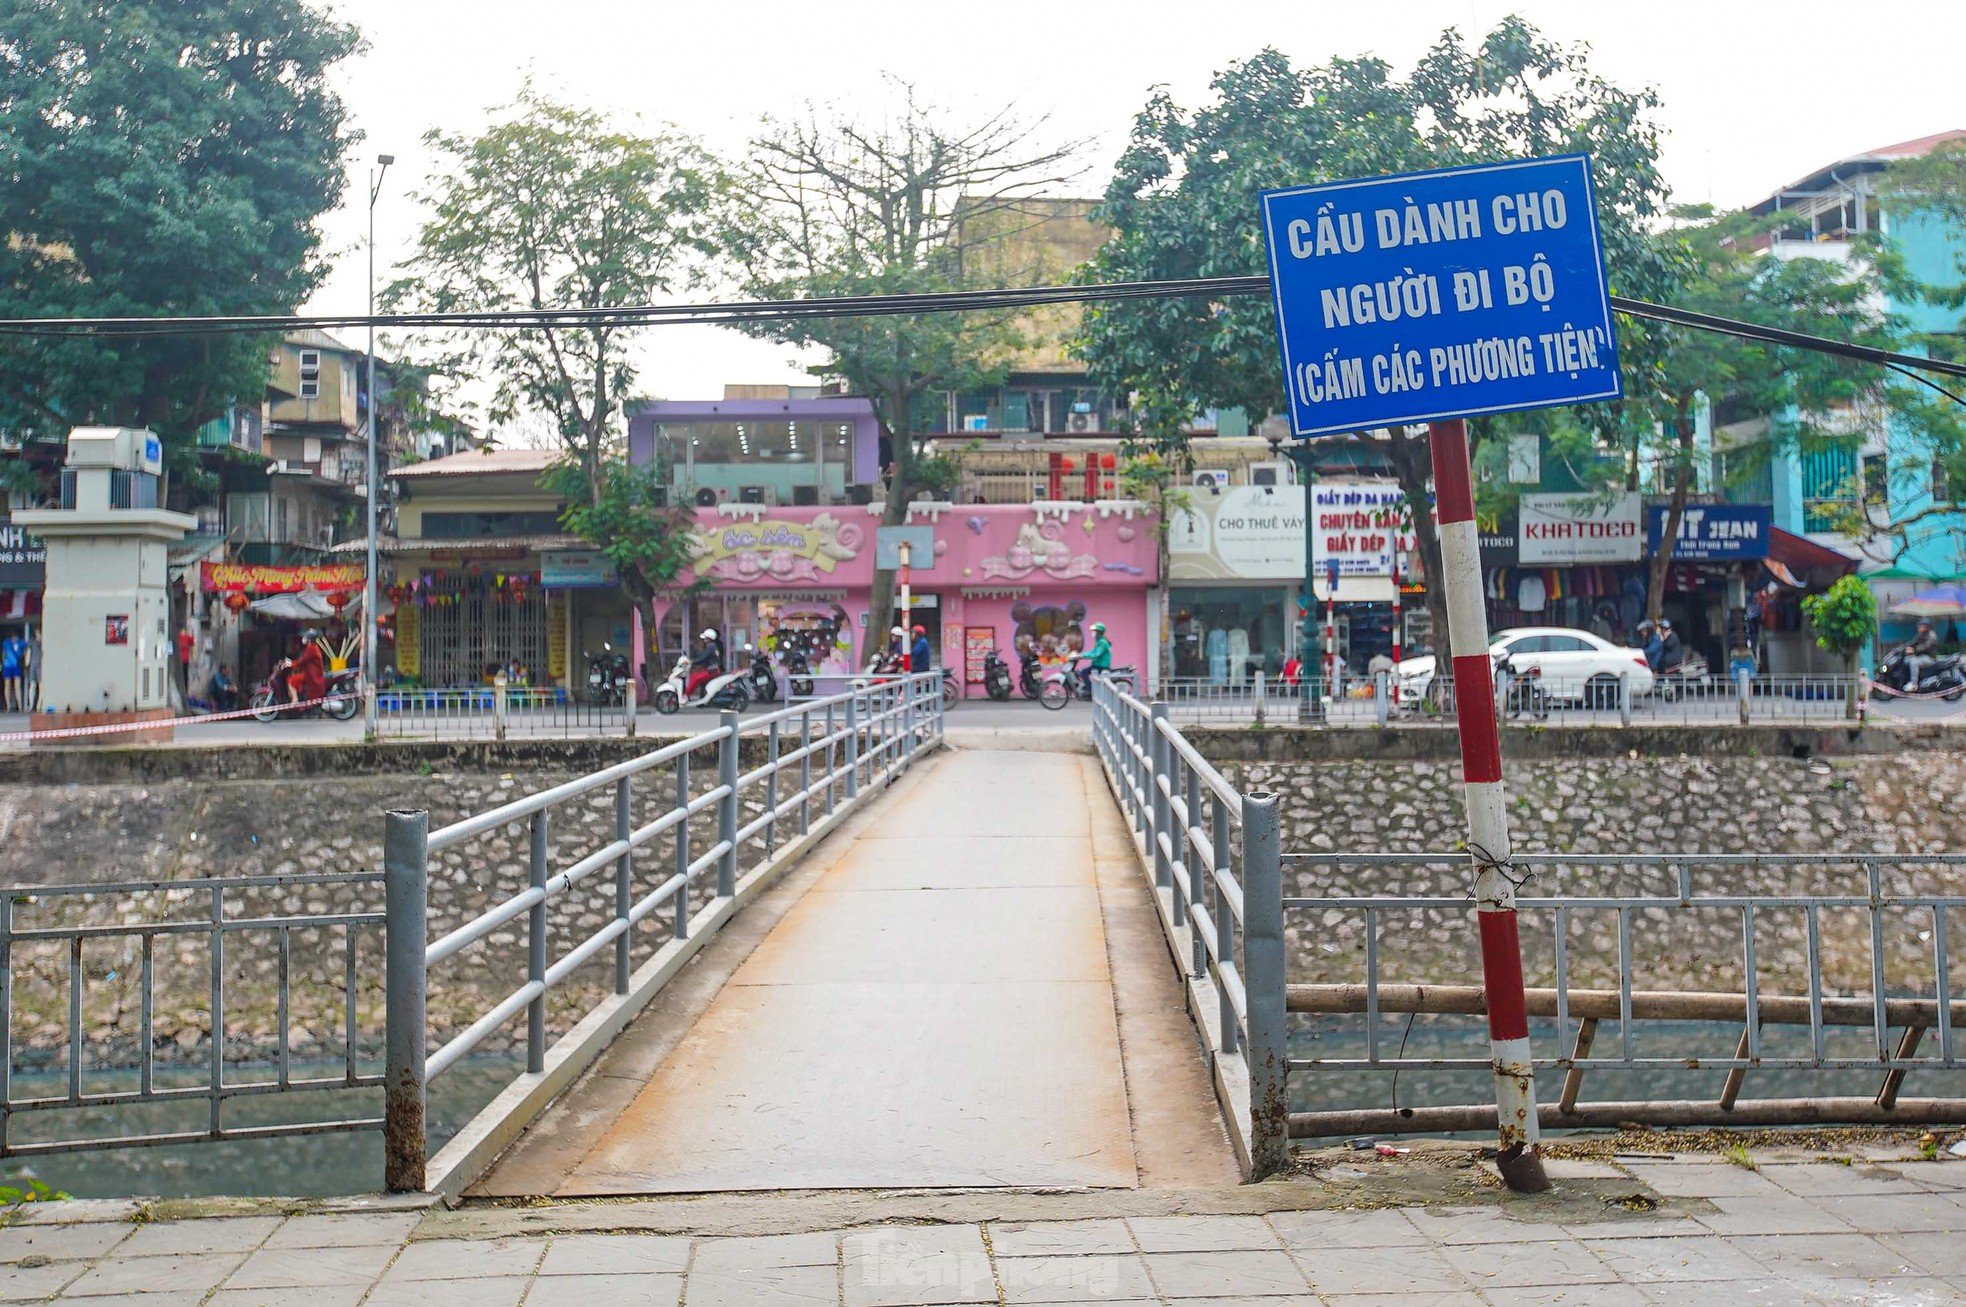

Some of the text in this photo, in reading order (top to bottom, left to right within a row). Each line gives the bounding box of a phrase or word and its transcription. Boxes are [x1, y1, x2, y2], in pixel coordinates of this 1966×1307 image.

[1288, 189, 1567, 259] CẦU DÀNH CHO
[1321, 252, 1555, 329] NGƯỜI ĐI BỘ
[1296, 347, 1367, 406] (CẤM
[1372, 343, 1424, 394] CÁC
[1430, 336, 1535, 387] PHƯƠNG
[1220, 518, 1244, 530] CHO
[1248, 515, 1279, 530] THUÊ
[1320, 510, 1370, 530] CHUYÊN
[1525, 521, 1635, 539] KHATOCO
[1360, 533, 1386, 552] DÉP
